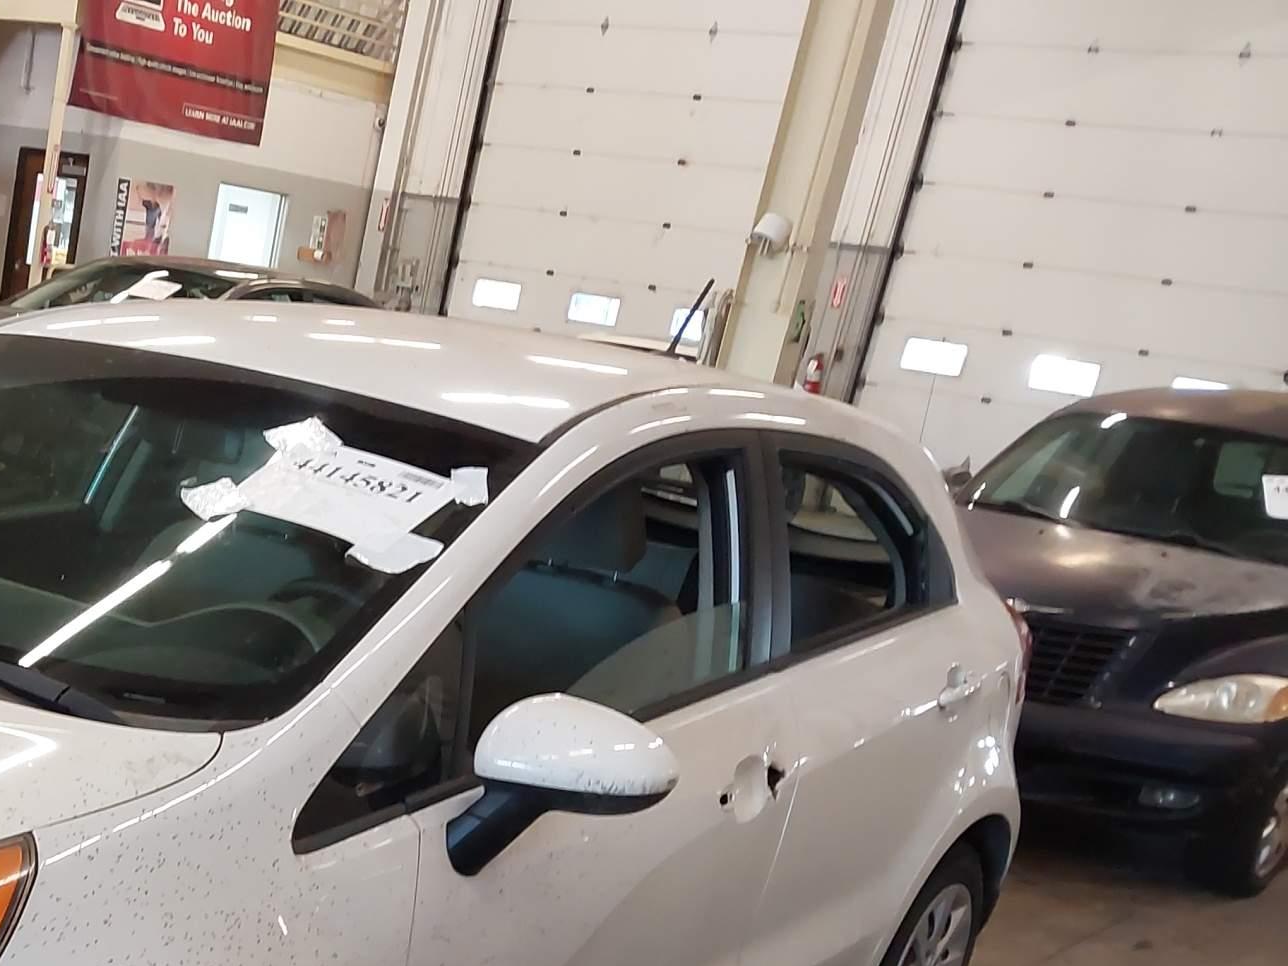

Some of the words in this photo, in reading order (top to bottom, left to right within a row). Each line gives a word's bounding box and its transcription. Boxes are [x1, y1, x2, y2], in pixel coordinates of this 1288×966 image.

[173, 17, 187, 37] To
[192, 22, 214, 45] You
[177, 0, 199, 17] The
[201, 2, 252, 32] Auction
[117, 182, 129, 207] IAA
[111, 208, 125, 246] WITH
[294, 458, 422, 503] 44145821
